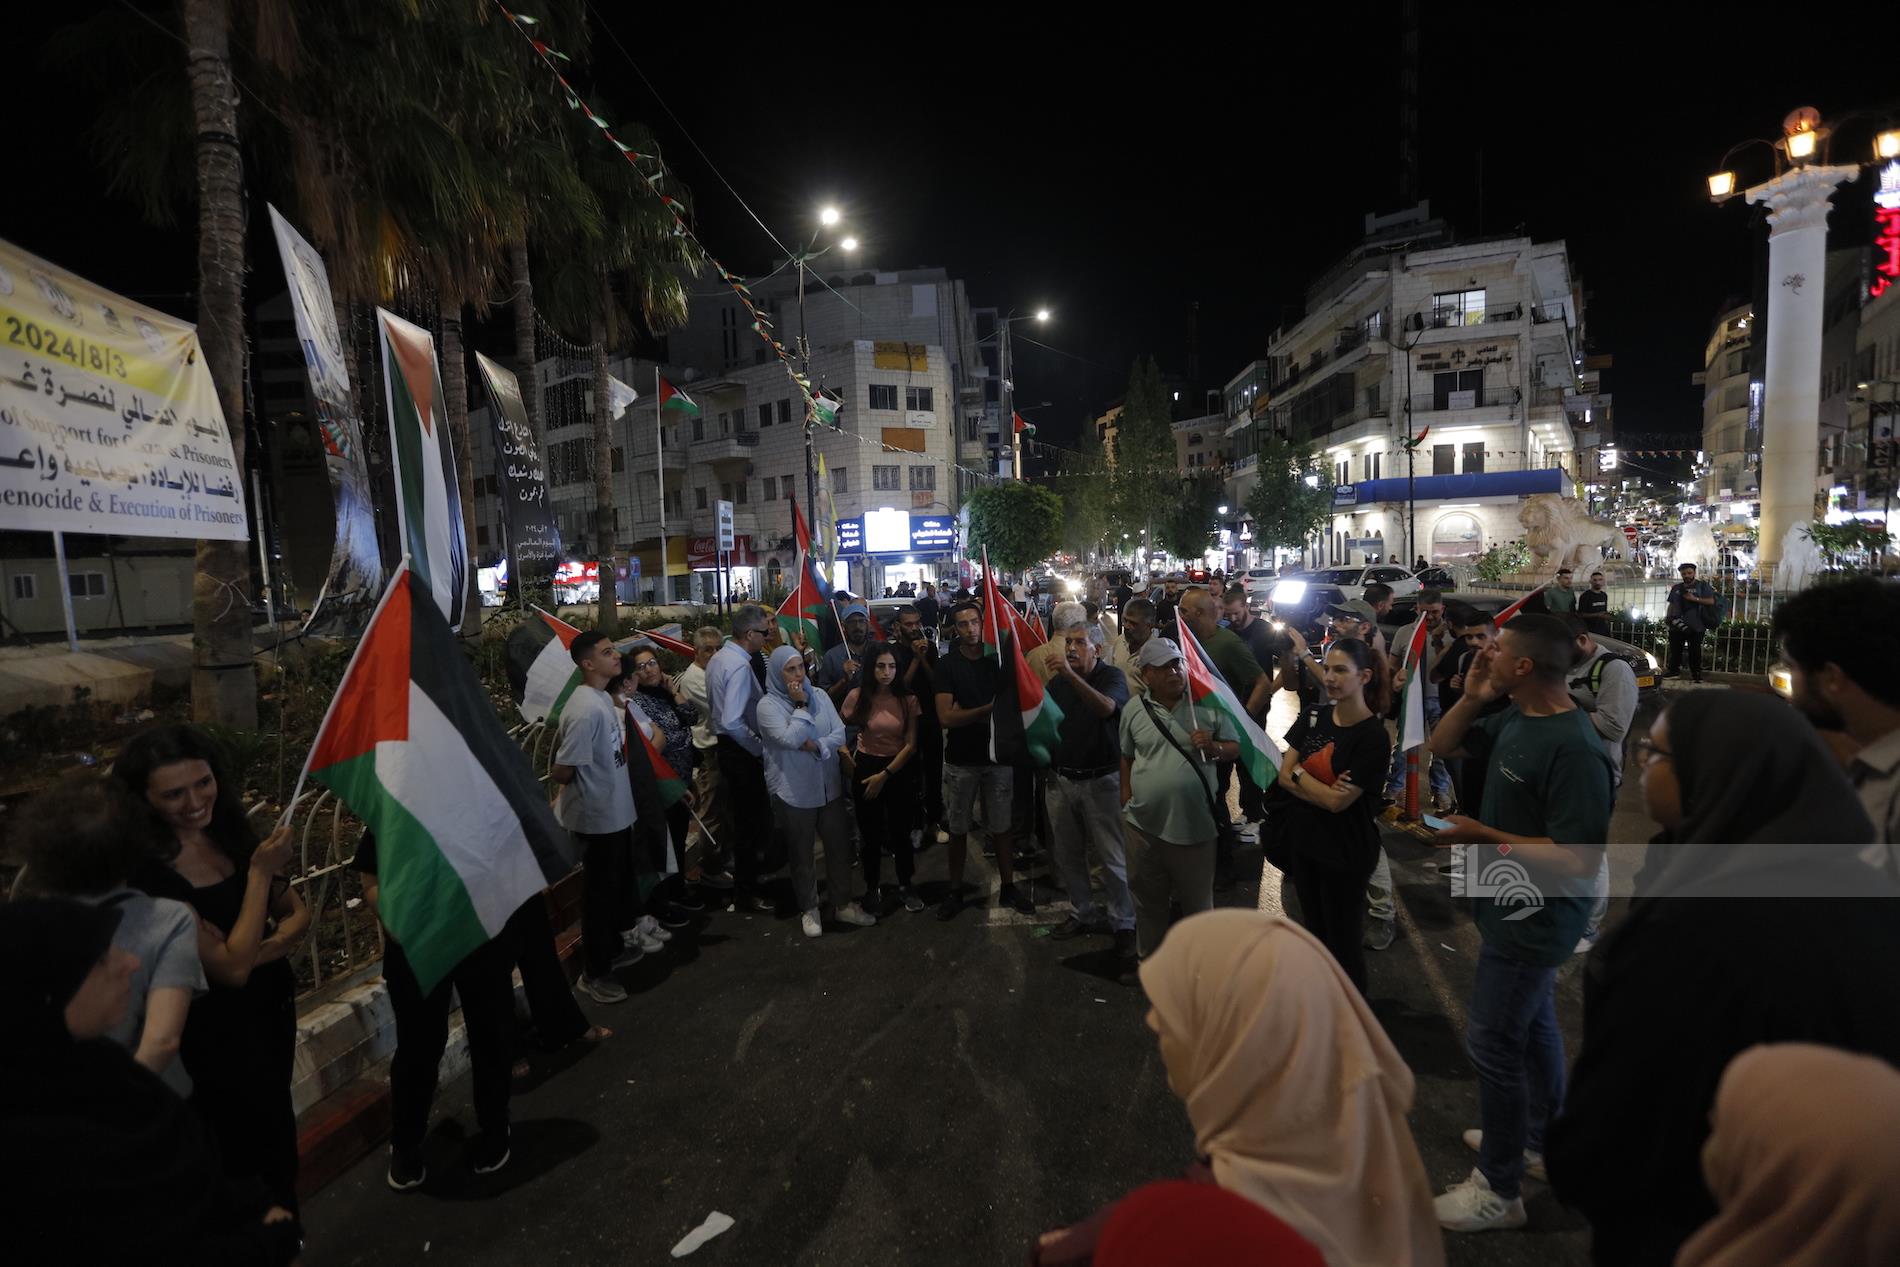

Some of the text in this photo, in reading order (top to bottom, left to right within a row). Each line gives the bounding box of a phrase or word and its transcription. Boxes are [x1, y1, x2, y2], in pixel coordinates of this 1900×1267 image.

[22, 409, 93, 445] Support
[97, 427, 119, 448] for
[184, 443, 233, 470] Prisoners
[89, 491, 104, 513] &
[110, 494, 176, 520] Execution
[179, 502, 192, 521] of
[195, 503, 243, 525] Prisoners
